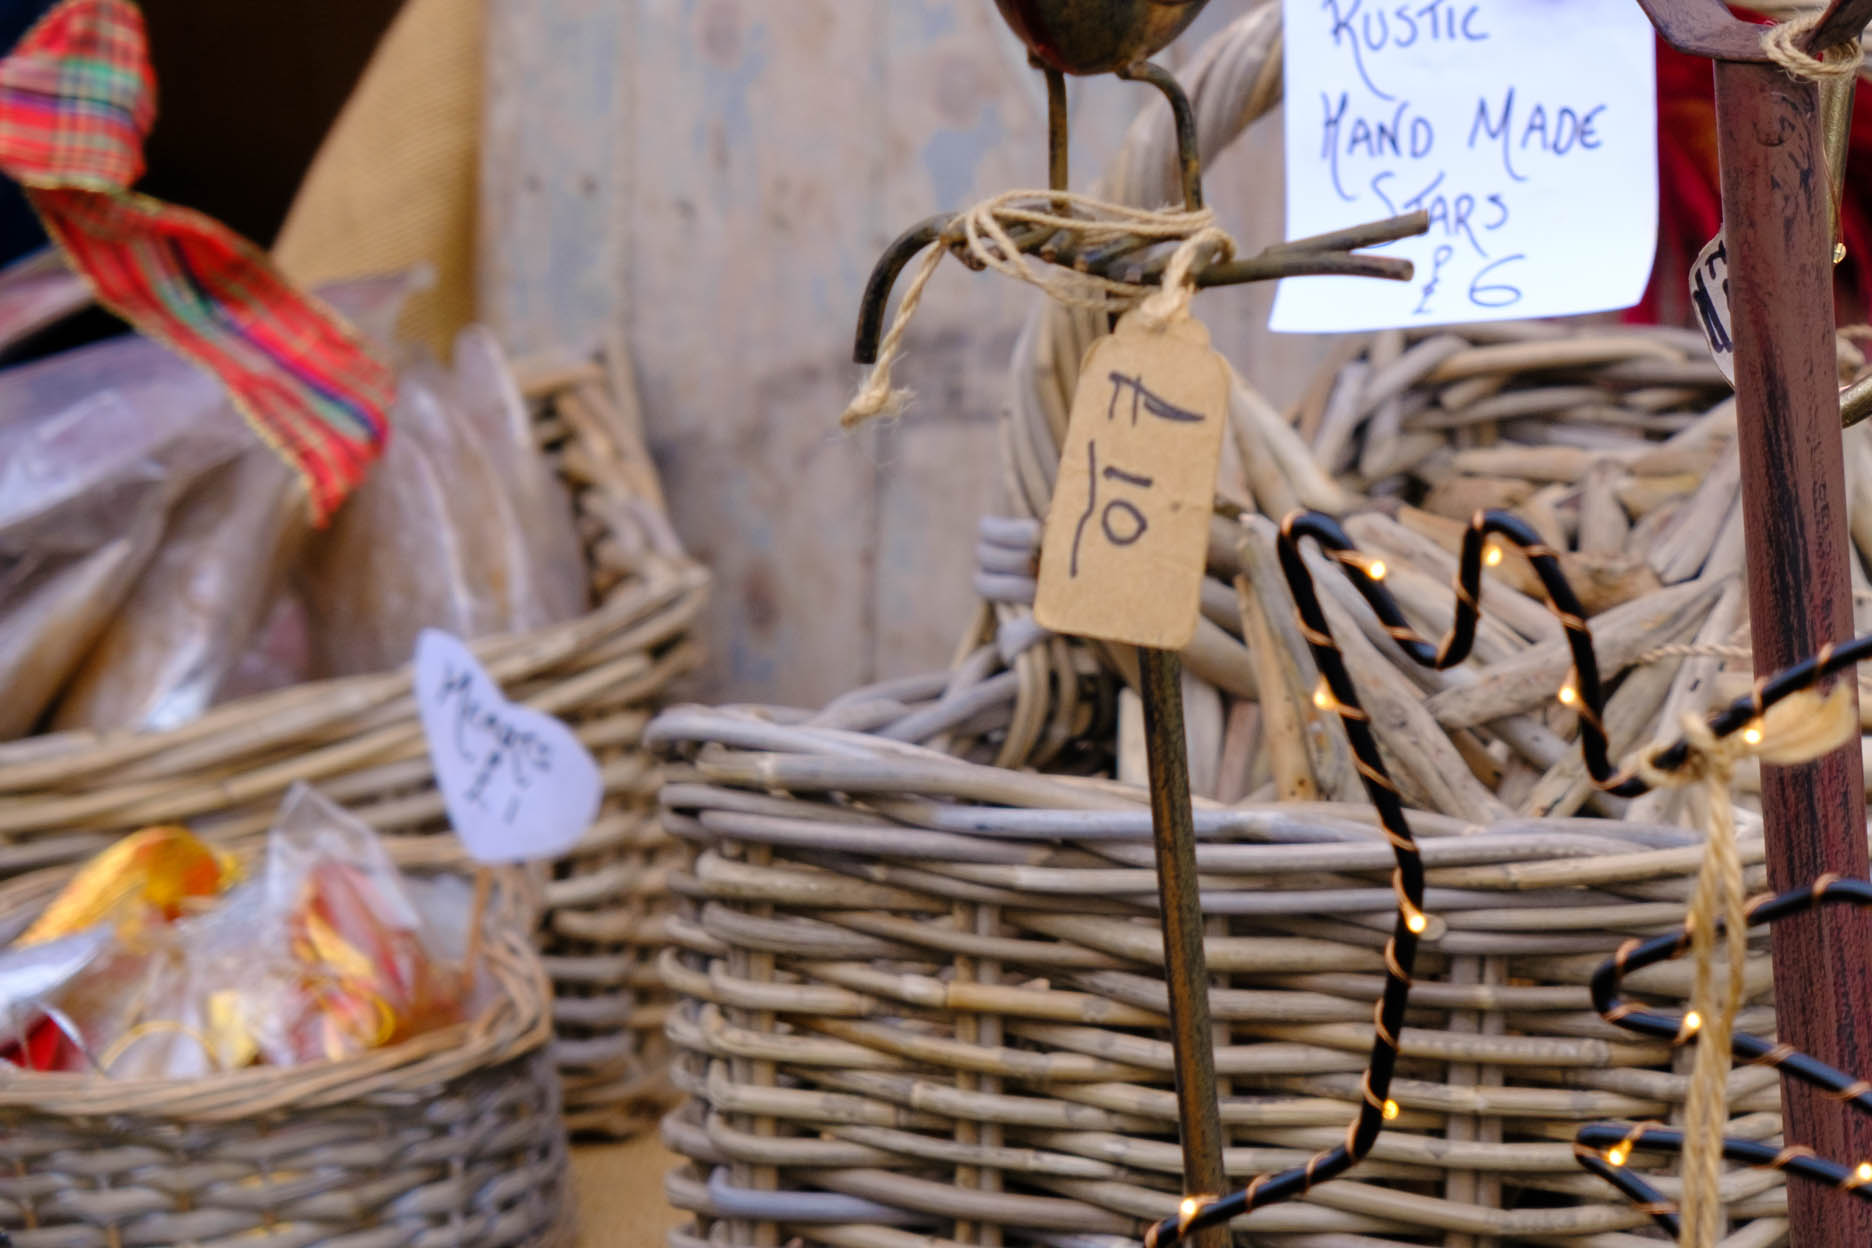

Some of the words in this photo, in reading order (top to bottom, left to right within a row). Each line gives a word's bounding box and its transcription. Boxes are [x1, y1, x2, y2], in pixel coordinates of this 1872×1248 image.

[1320, 91, 1434, 201] HAND
[1467, 84, 1608, 182] MADE
[1411, 243, 1527, 315] £6
